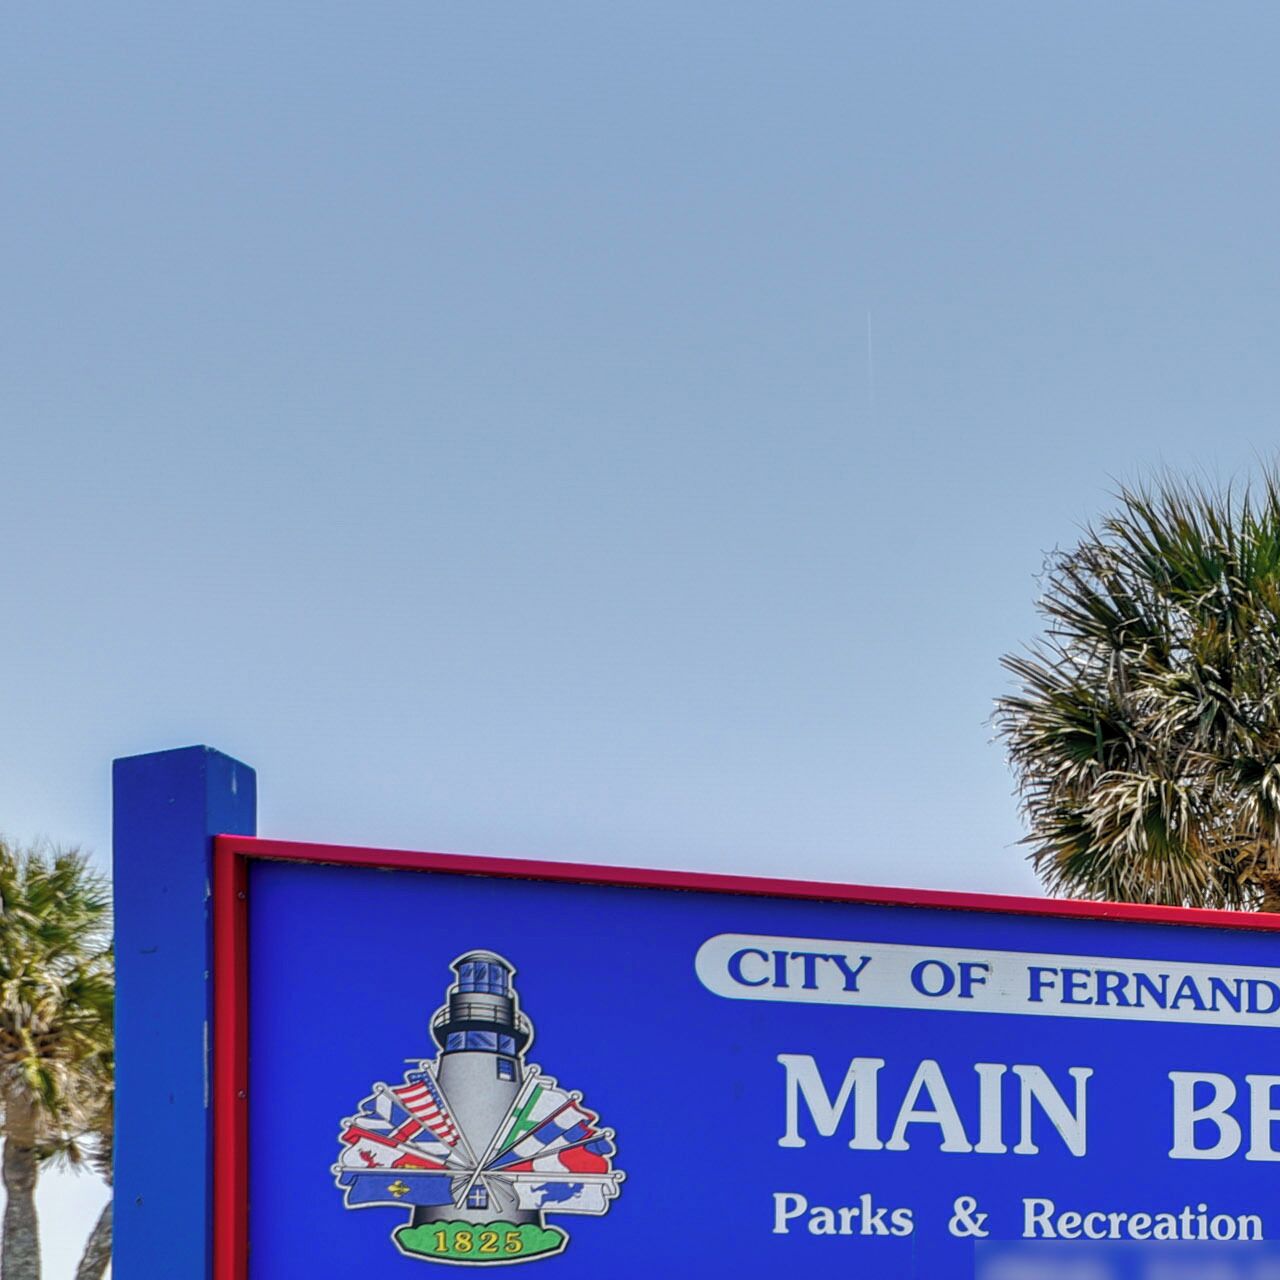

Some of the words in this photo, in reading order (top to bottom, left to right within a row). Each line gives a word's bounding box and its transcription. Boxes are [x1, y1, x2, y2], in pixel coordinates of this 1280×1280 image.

[727, 947, 873, 993] CITY
[910, 959, 990, 999] OF
[777, 1053, 1094, 1157] MAIN
[434, 1229, 524, 1254] 1825
[772, 1192, 914, 1237] Parks
[948, 1195, 989, 1238] &
[1022, 1198, 1264, 1241] Recreation
